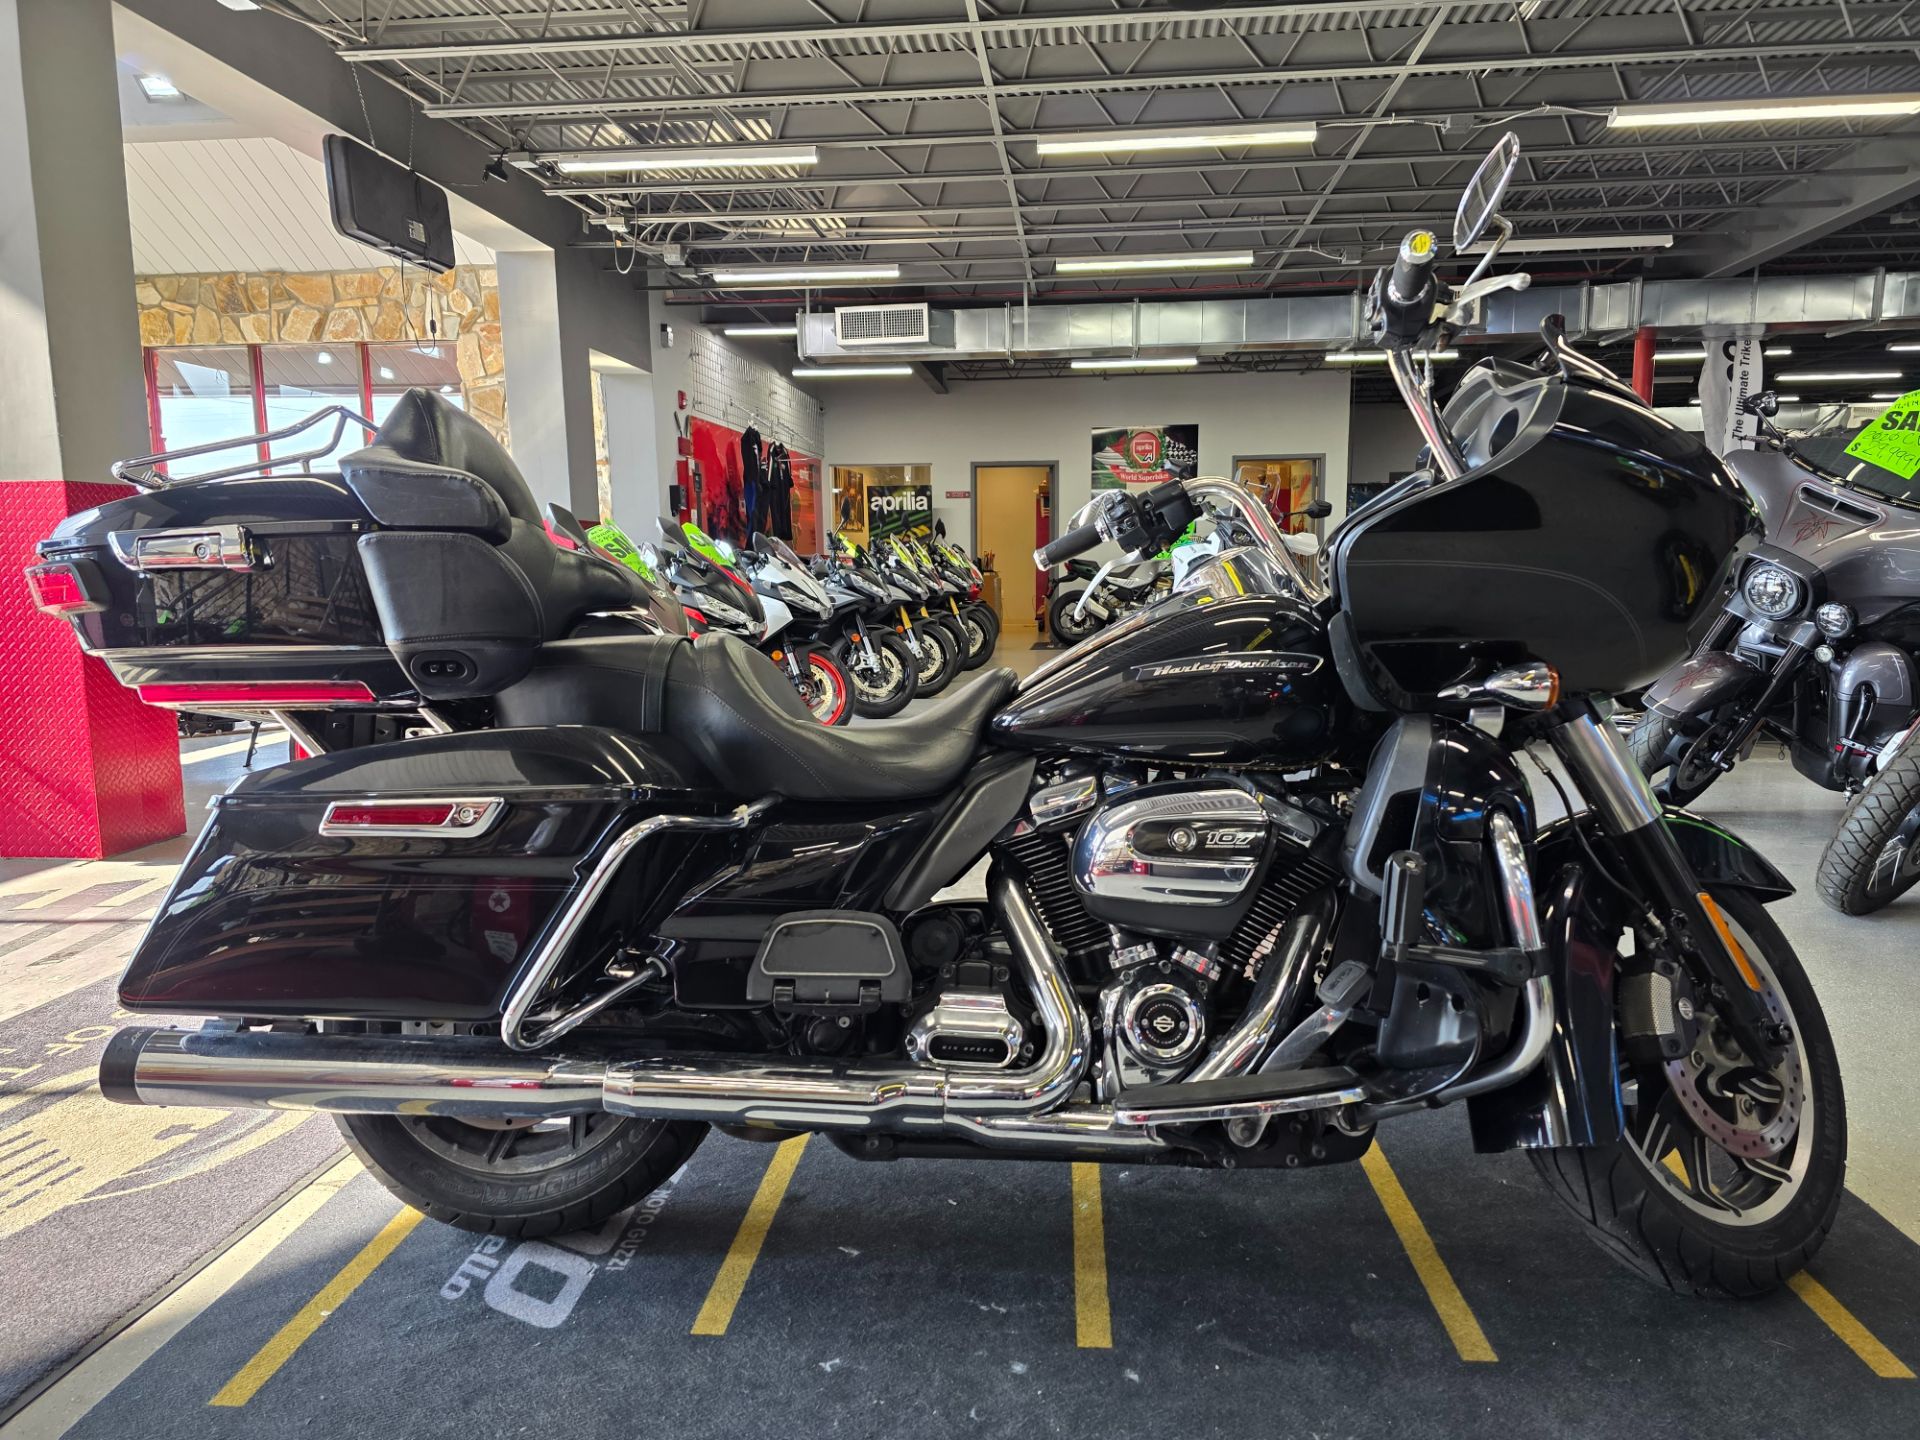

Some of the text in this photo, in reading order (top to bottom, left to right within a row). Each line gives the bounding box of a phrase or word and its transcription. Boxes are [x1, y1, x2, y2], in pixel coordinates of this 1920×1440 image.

[1731, 339, 1752, 440] The Ultimate Trike
[1881, 410, 1920, 431] SA
[1120, 472, 1137, 481] World
[870, 491, 928, 514] aprilia
[1206, 831, 1257, 845] 107
[516, 1139, 623, 1201] MICHELIN
[638, 1188, 673, 1225] MOTO
[440, 1234, 507, 1300] ello
[606, 1228, 648, 1271] GUZZI
